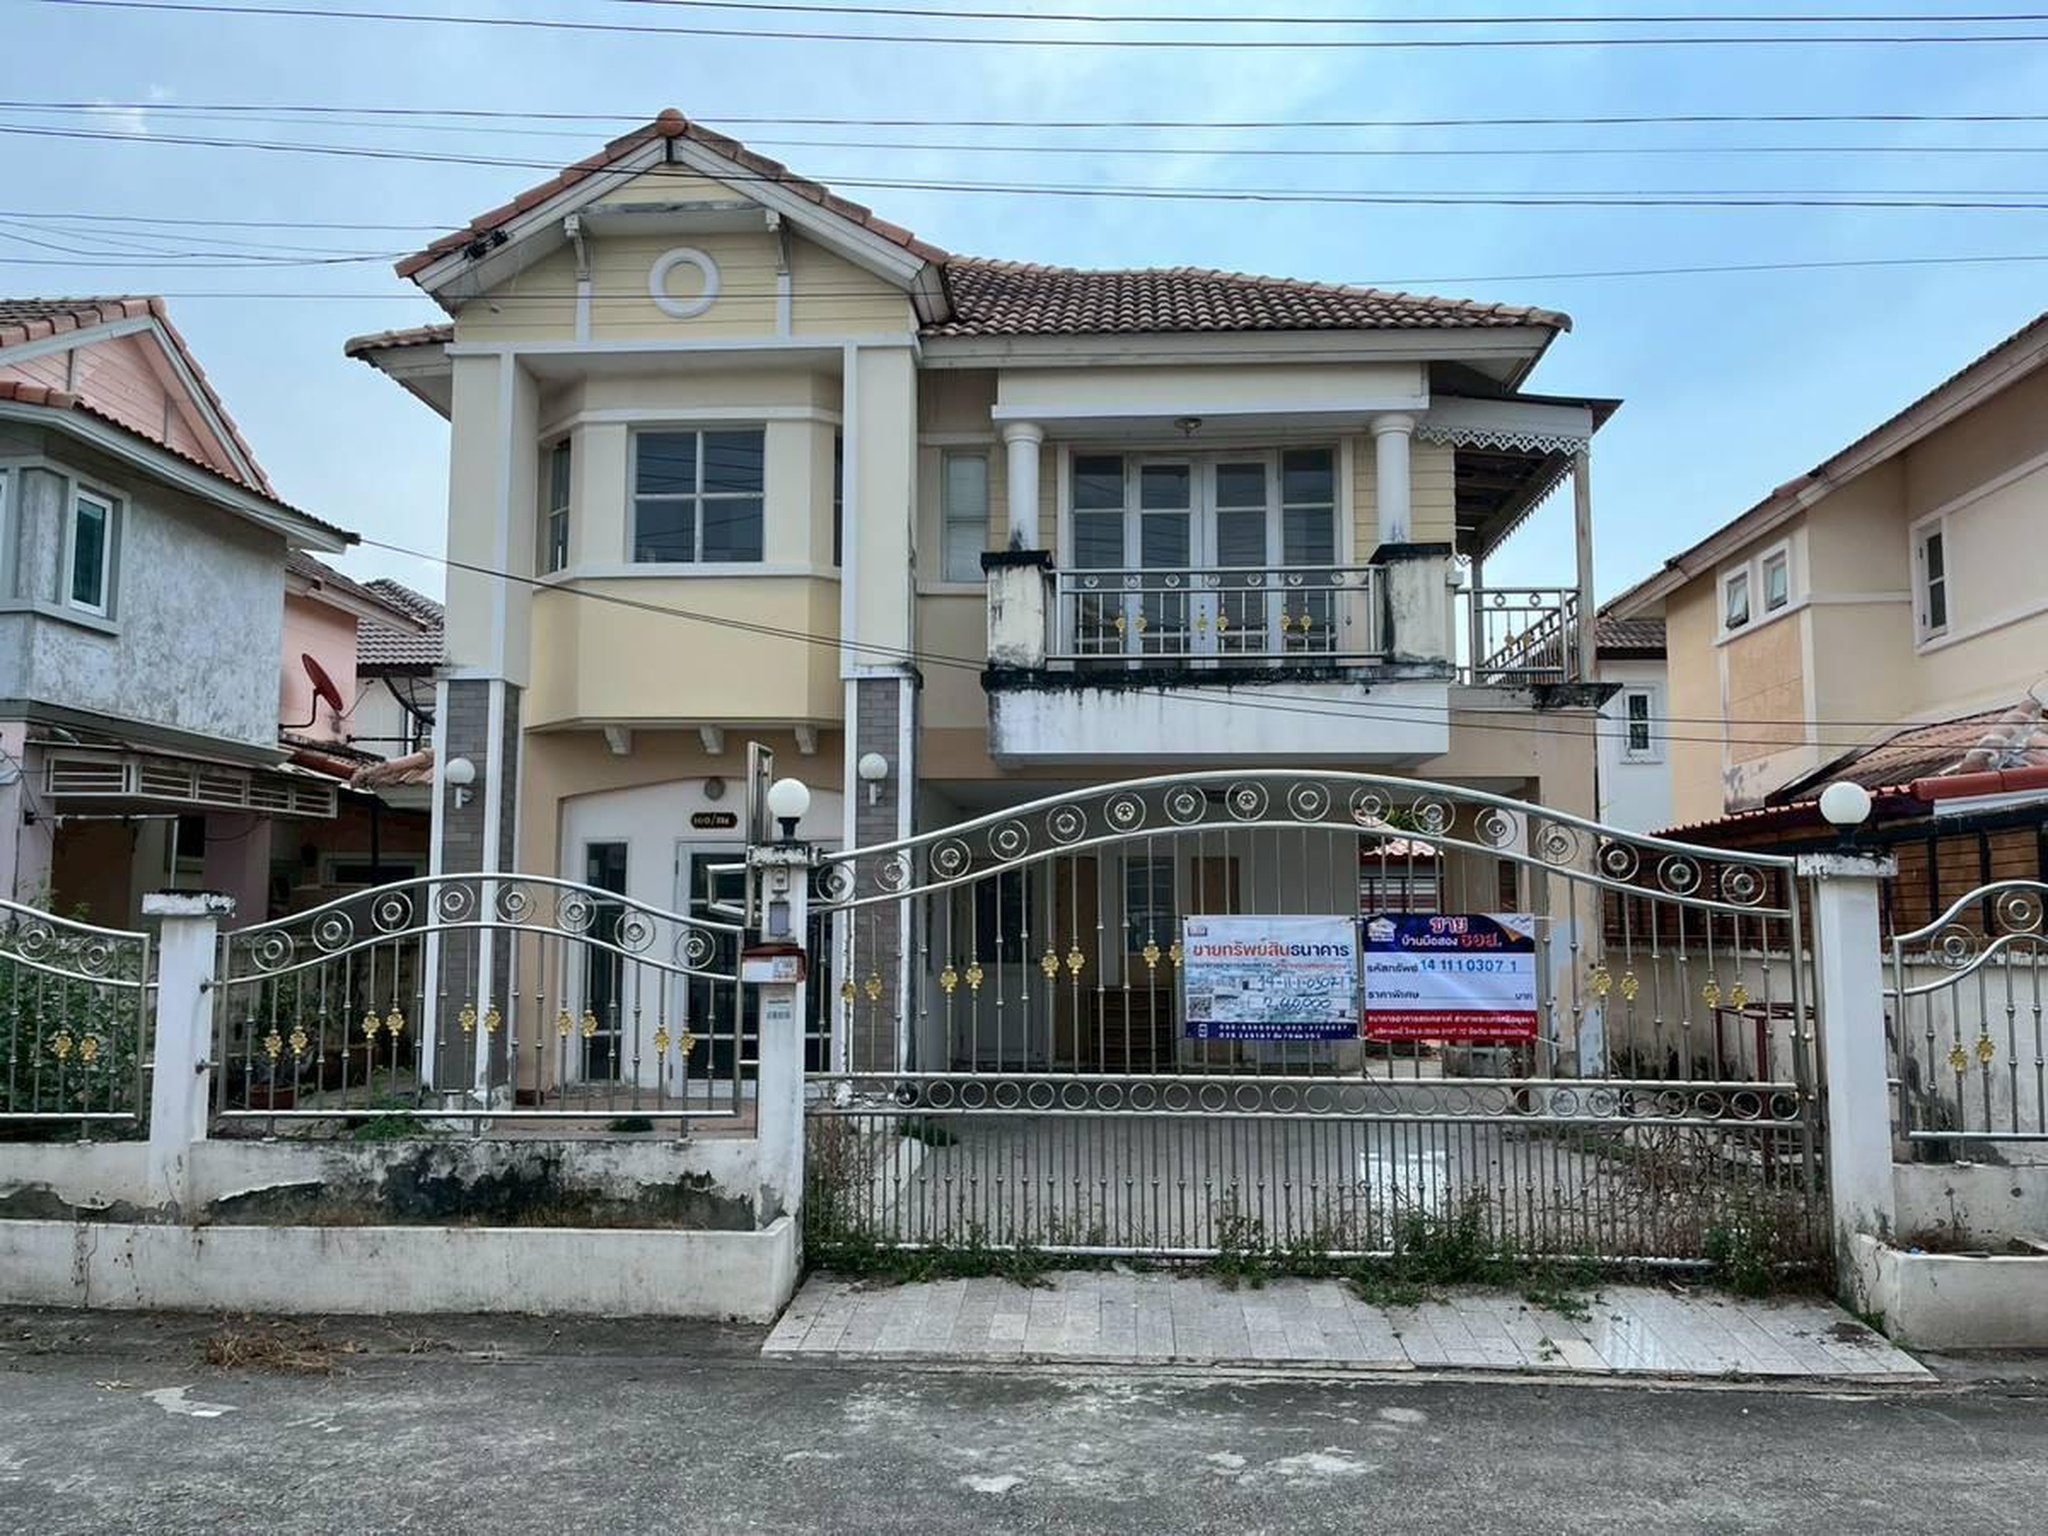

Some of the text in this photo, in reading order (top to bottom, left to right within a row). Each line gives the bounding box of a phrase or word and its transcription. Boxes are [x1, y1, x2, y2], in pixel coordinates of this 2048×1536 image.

[1429, 916, 1468, 933] ขาย
[1193, 938, 1350, 956] ขายทรัพย์สินธนาคาร
[1402, 934, 1458, 946] บ้านมือสอง
